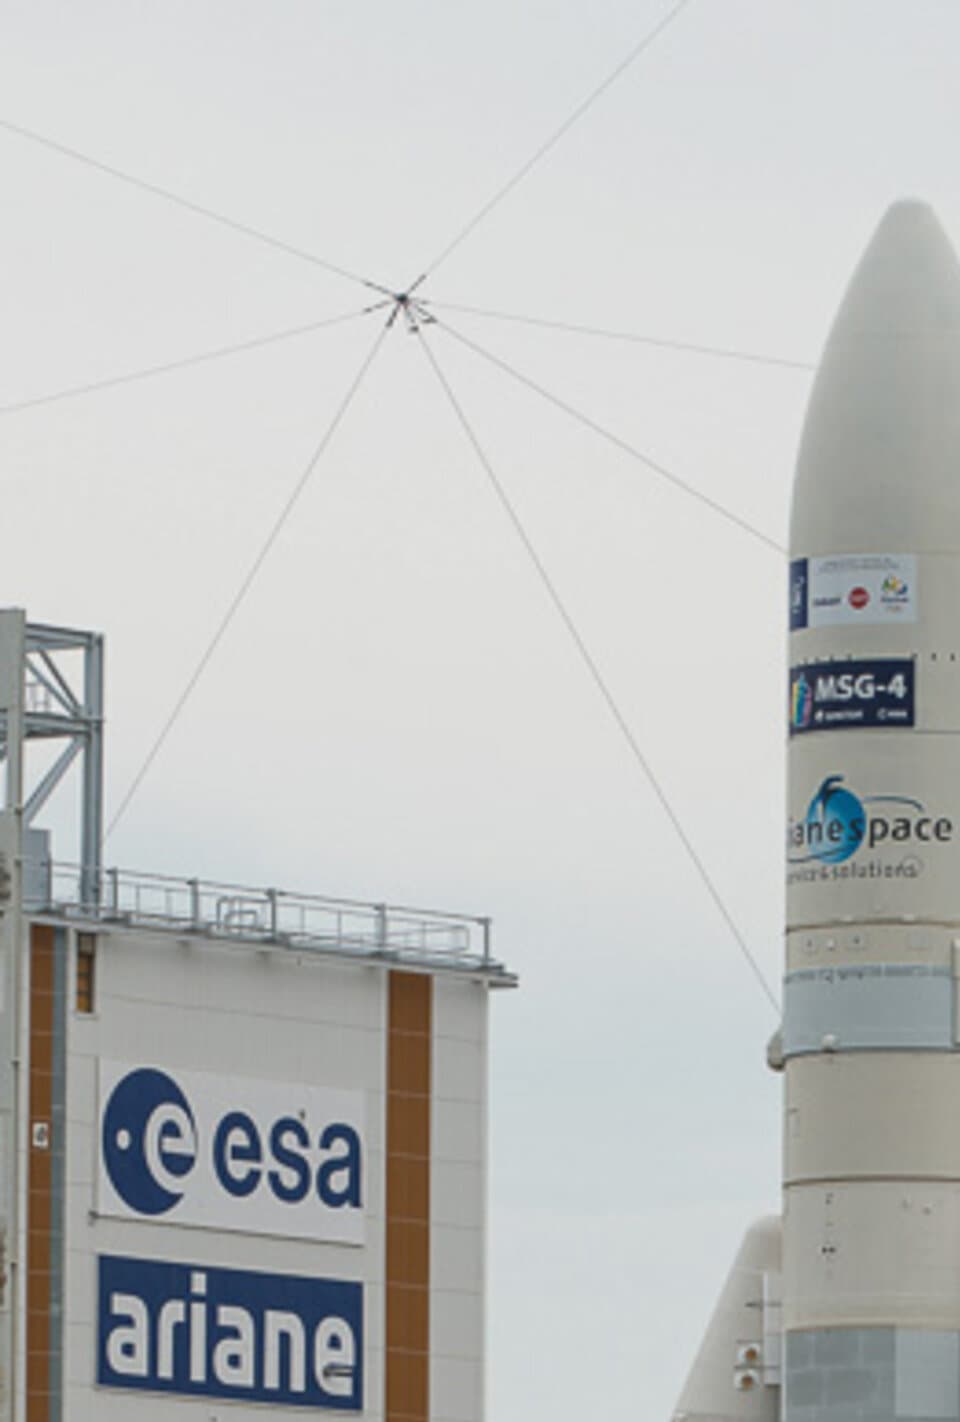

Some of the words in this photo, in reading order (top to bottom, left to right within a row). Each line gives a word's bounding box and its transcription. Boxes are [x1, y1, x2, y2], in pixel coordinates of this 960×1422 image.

[815, 674, 906, 700] MSG-4
[213, 1111, 363, 1208] esa
[106, 1271, 356, 1396] ariane
